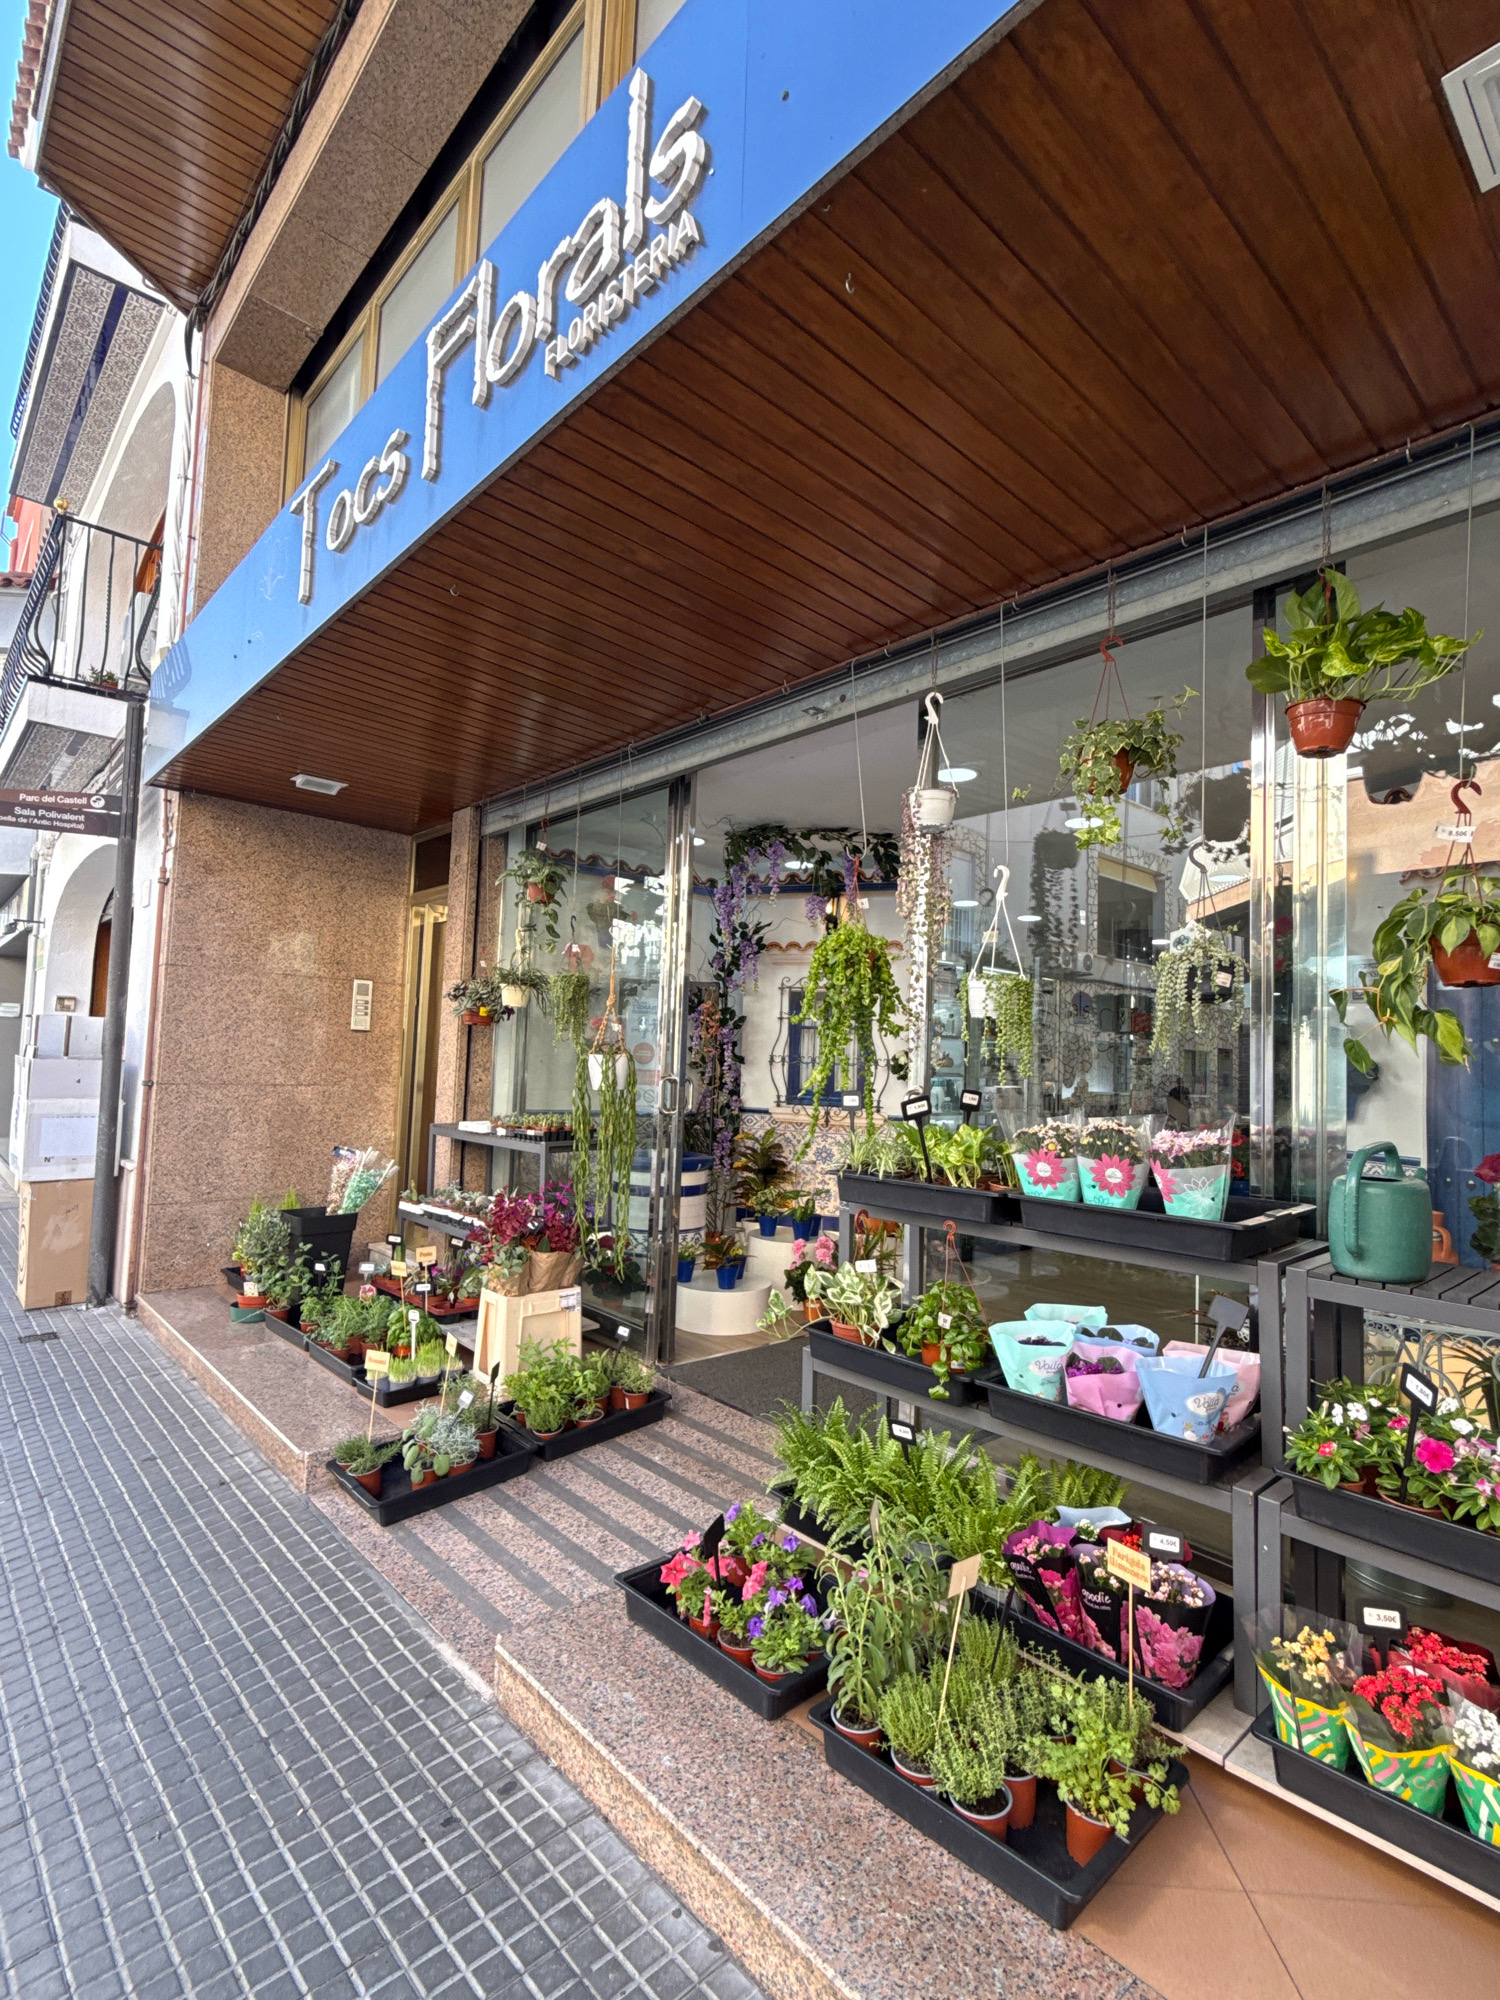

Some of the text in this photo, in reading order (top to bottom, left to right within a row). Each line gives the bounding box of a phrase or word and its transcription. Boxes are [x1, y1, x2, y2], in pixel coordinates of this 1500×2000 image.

[544, 210, 701, 379] FLORISTERIA
[289, 67, 706, 605] Tocs Florals
[19, 793, 88, 805] Parc del Castell
[14, 806, 85, 822] Sala Polivalent
[53, 820, 85, 830] Hospital)
[1112, 1546, 1146, 1571] Farigola
[1081, 1588, 1112, 1604] goodie
[1376, 1613, 1397, 1623] 3,50€
